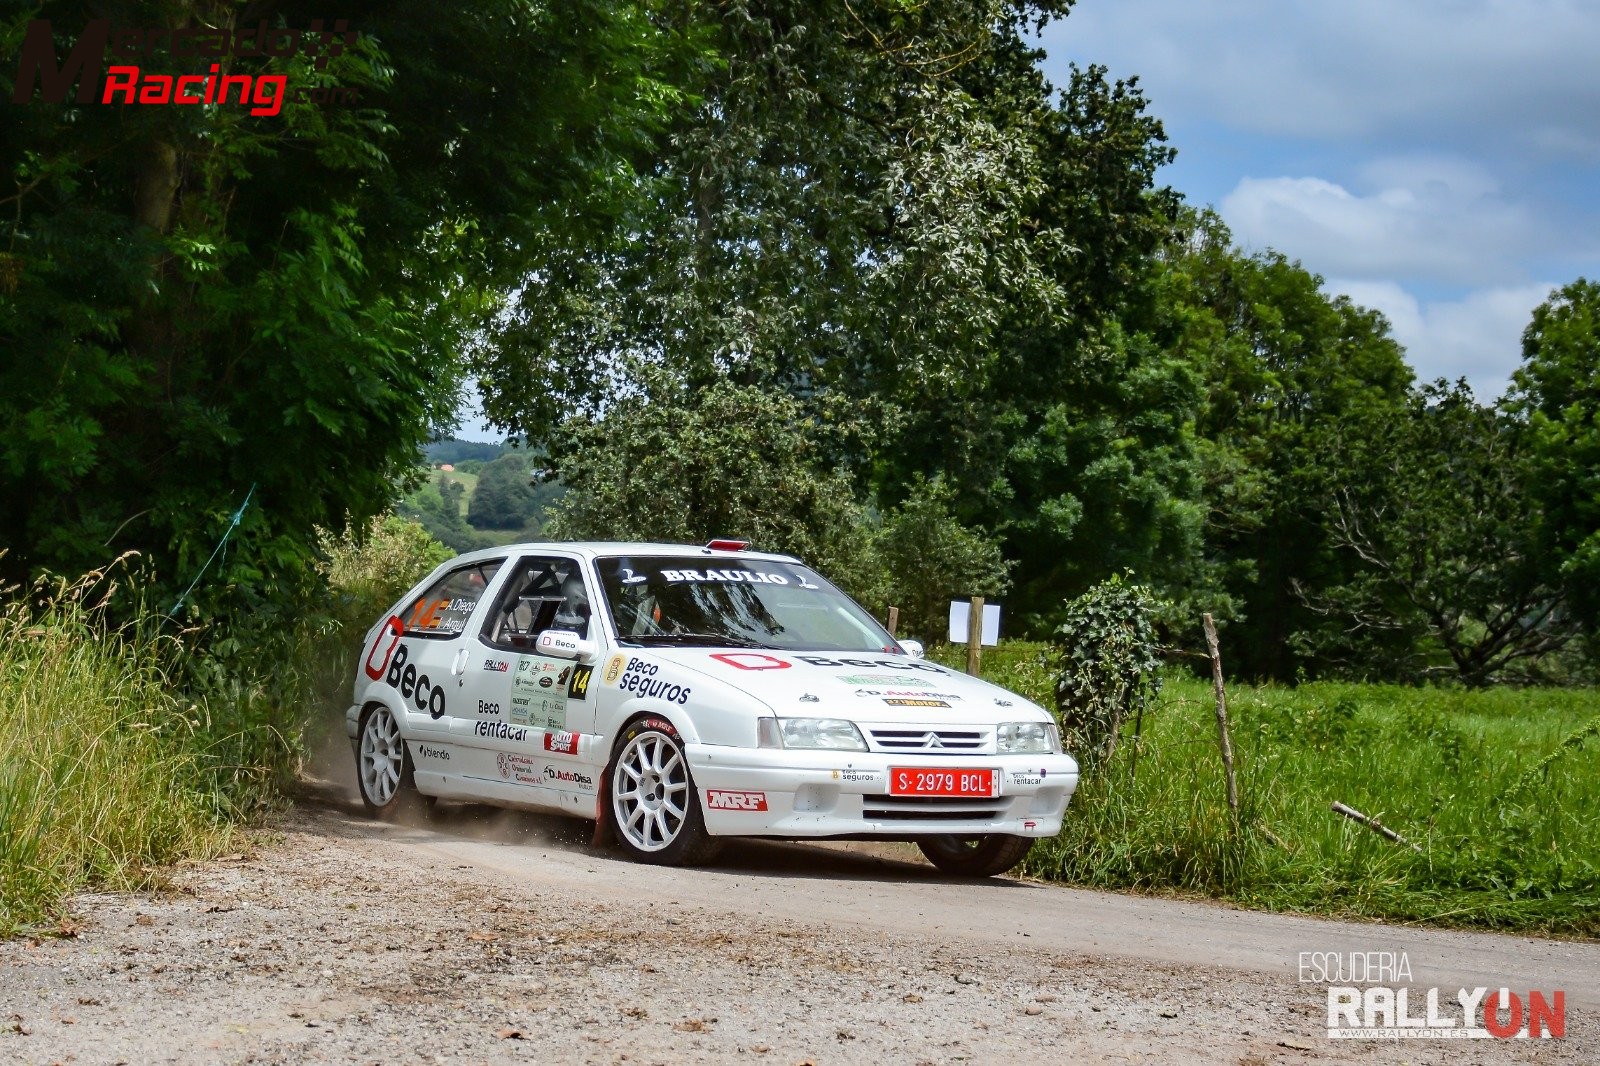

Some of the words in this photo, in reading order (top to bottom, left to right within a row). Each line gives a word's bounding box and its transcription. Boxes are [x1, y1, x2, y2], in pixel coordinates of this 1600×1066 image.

[661, 570, 788, 585] BRAULIO
[408, 598, 440, 630] 14
[556, 640, 576, 649] Beco
[626, 657, 659, 676] Beco
[792, 655, 949, 675] Beco
[386, 643, 446, 720] Beco
[573, 670, 591, 694] 14
[619, 672, 692, 705] seguros
[478, 699, 500, 715] Beco
[474, 719, 528, 741] rentacar
[842, 774, 874, 782] seguros
[899, 773, 909, 791] S
[916, 773, 954, 791] 2979
[960, 774, 986, 792] BCL
[709, 793, 764, 810] MRF
